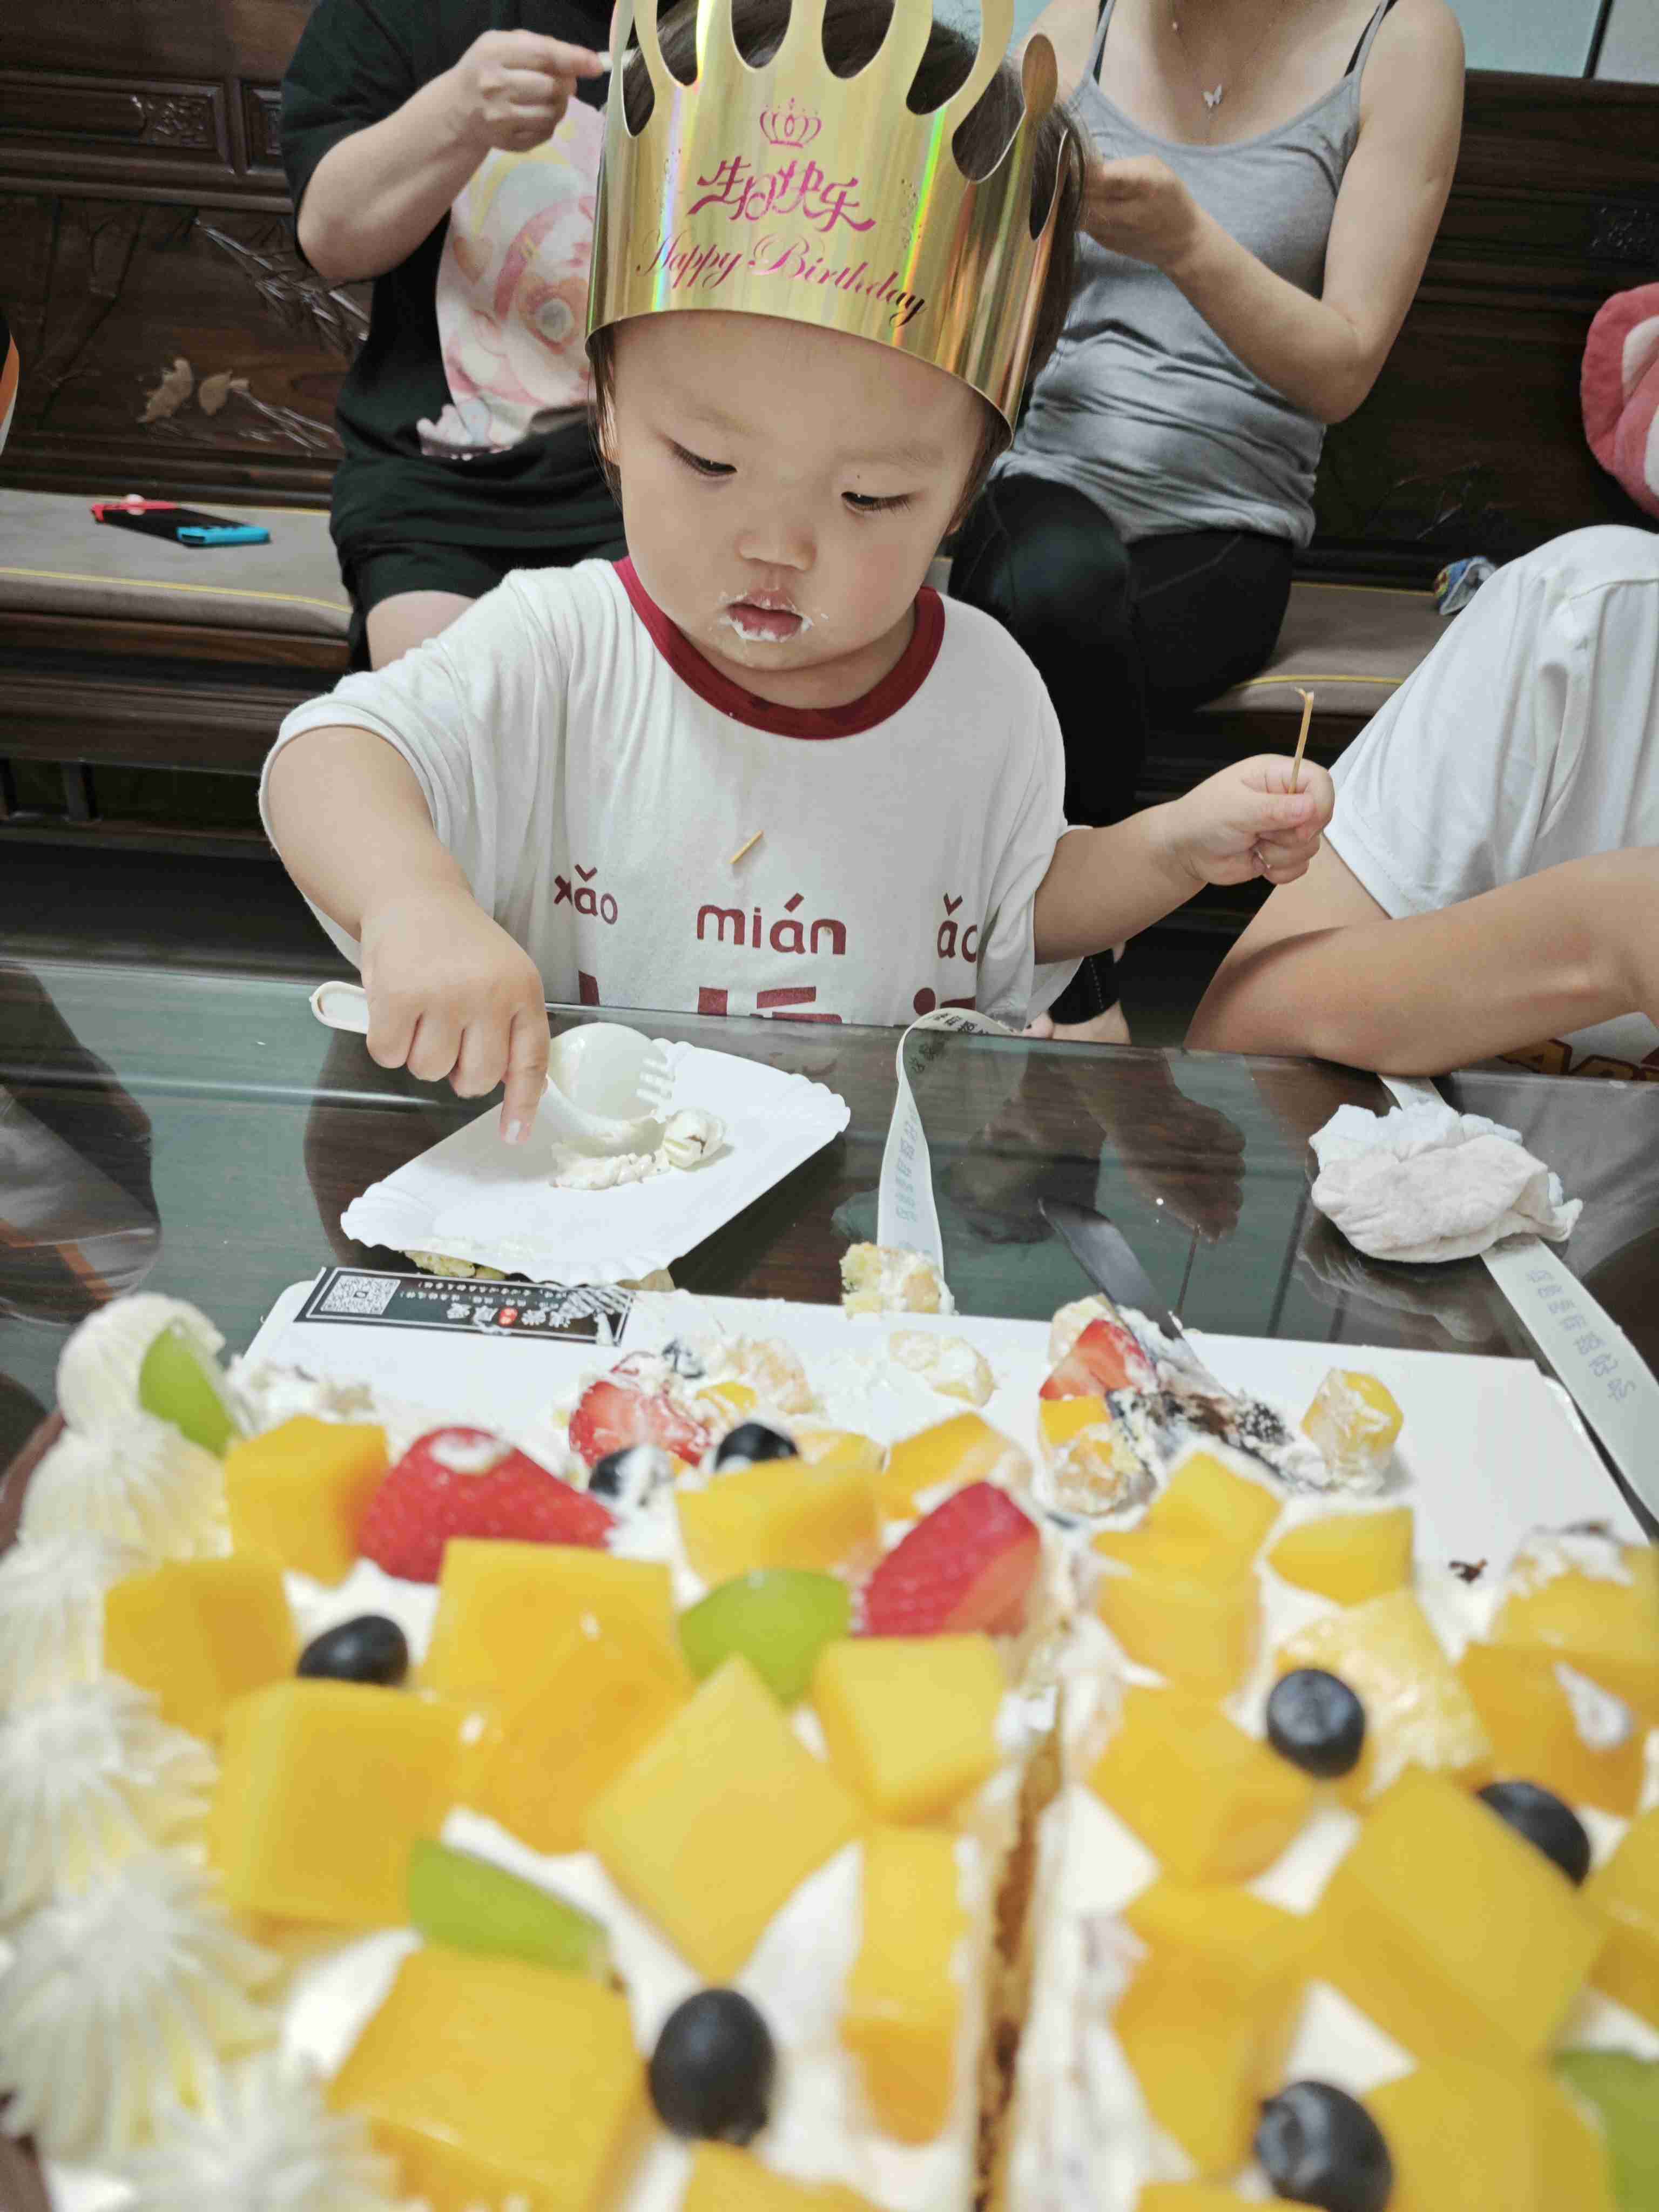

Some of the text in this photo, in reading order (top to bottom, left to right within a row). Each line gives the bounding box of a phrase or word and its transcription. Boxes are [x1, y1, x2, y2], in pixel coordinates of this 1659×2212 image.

[687, 155, 876, 232] 生日快乐
[636, 229, 925, 327] Happy Birthday
[697, 892, 847, 955] mián
